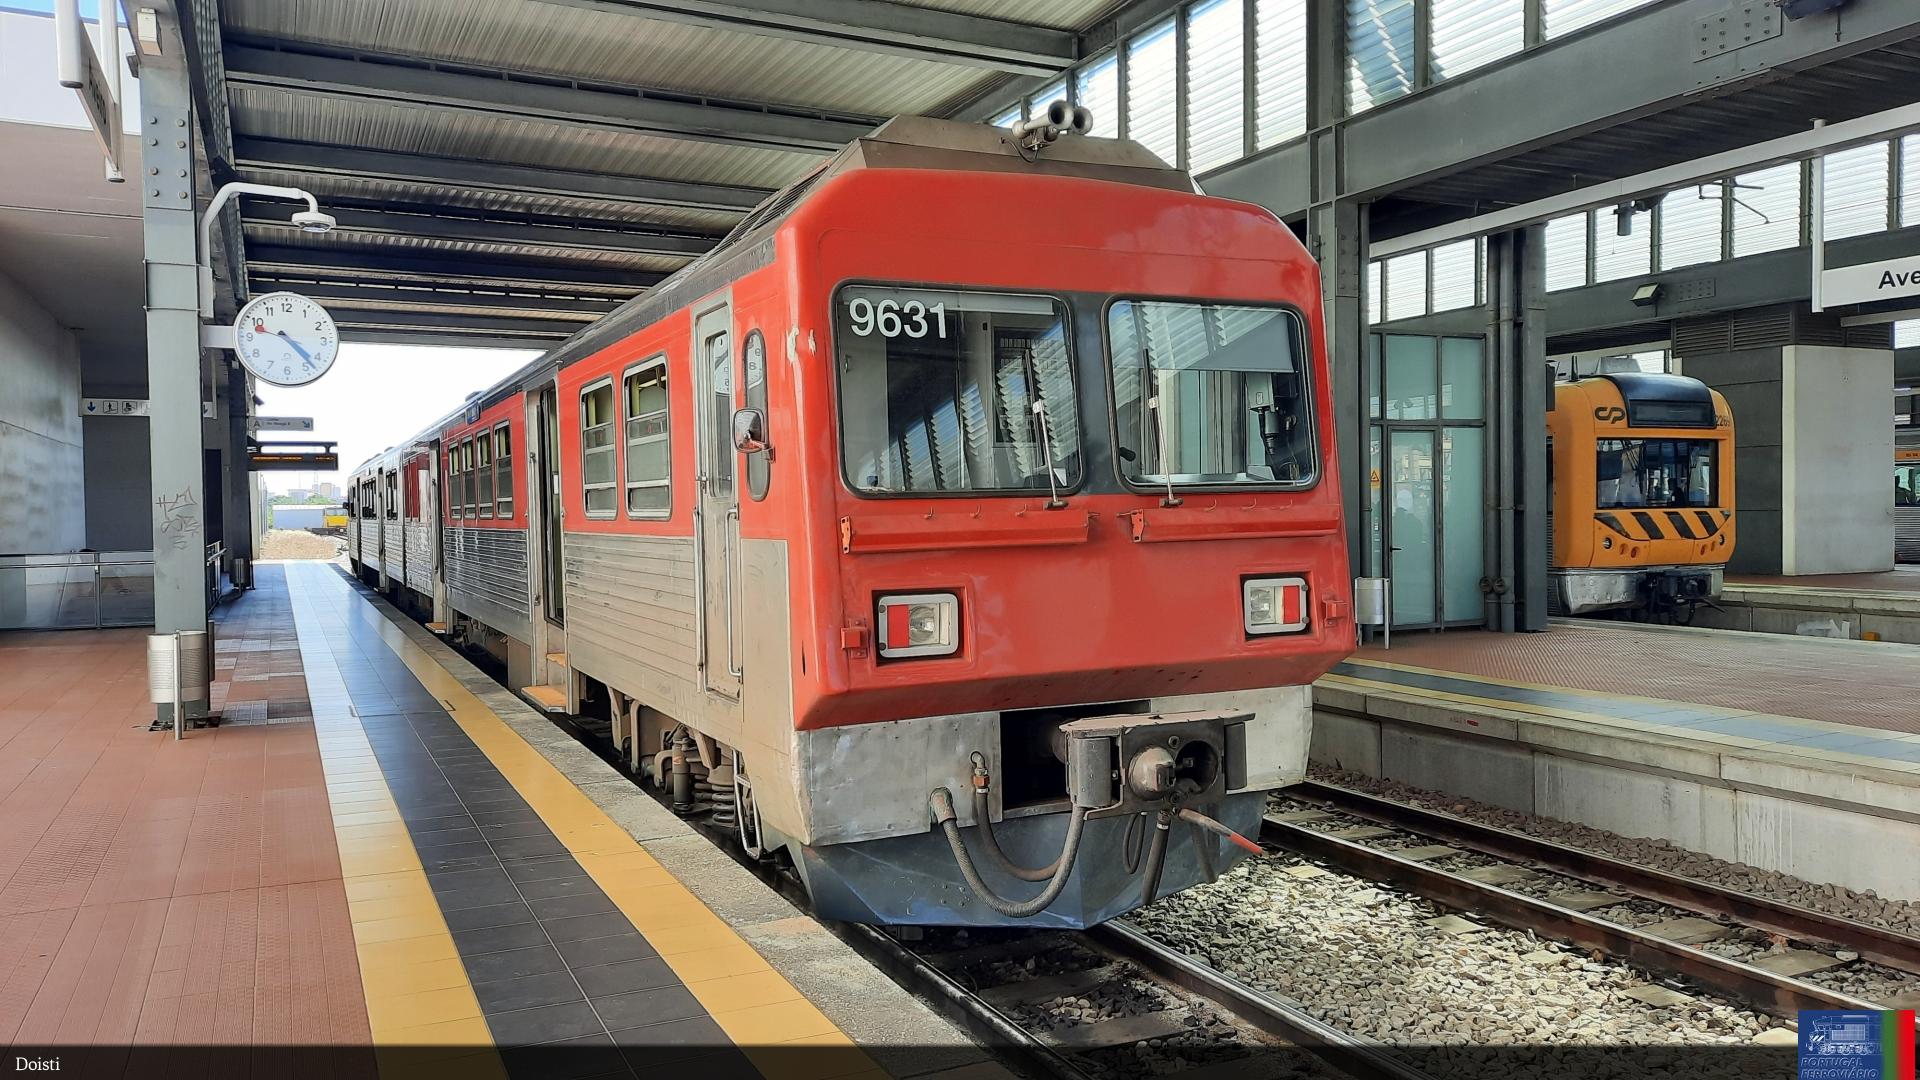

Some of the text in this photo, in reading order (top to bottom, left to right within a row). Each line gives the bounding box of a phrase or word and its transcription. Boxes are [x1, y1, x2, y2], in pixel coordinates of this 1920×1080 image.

[1878, 270, 1920, 289] Ave
[265, 307, 273, 316] 11
[281, 303, 293, 313] 12
[303, 309, 307, 318] 1
[849, 298, 946, 338] 9631
[252, 317, 264, 326] 10
[315, 321, 322, 331] 2
[246, 332, 253, 341] 9
[320, 337, 327, 346] 3
[252, 348, 260, 358] 8
[314, 353, 321, 361] 4
[267, 361, 274, 369] 7
[302, 362, 309, 371] 5
[284, 366, 291, 375] 6
[1594, 407, 1625, 424] CP
